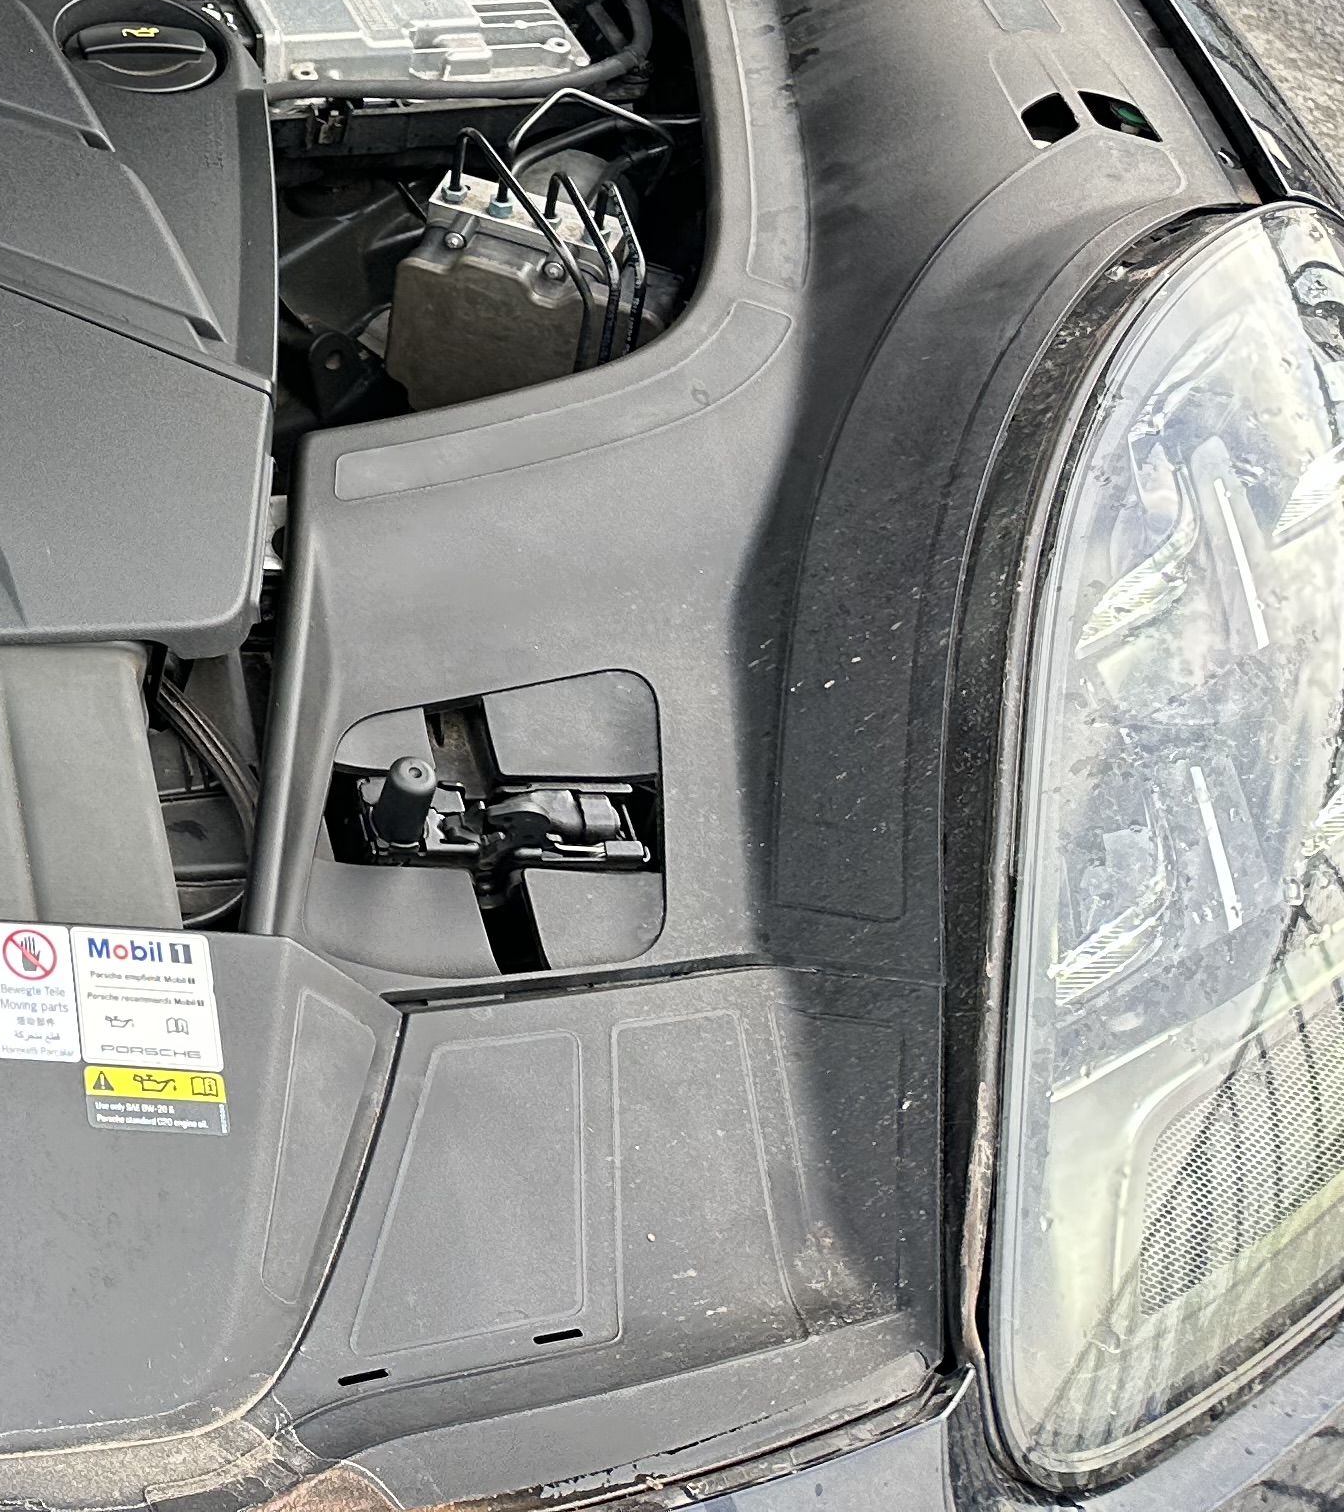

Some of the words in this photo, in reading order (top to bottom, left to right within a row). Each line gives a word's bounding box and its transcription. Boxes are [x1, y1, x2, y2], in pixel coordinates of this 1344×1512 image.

[87, 936, 163, 963] Mobil
[171, 943, 191, 964] 1
[0, 998, 38, 1013] Moving
[40, 1001, 69, 1014] parts
[100, 1044, 202, 1059] PORSCHE
